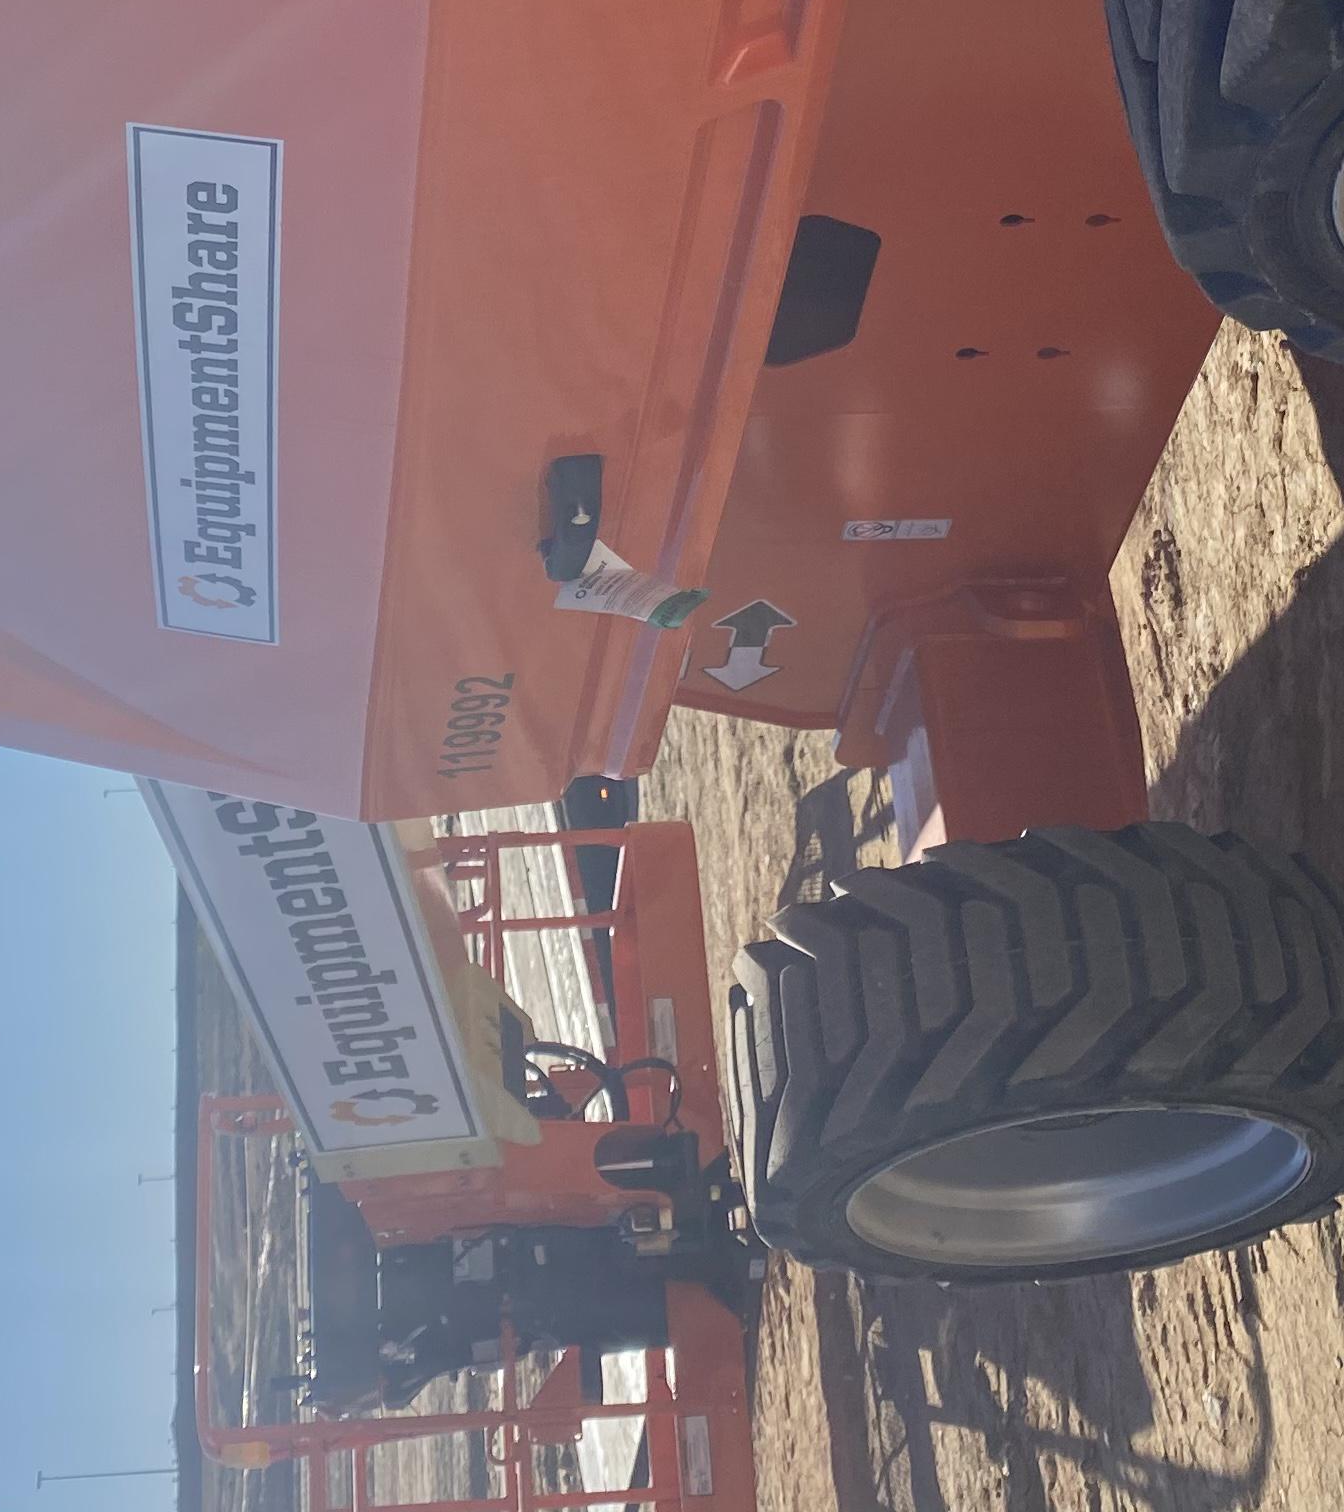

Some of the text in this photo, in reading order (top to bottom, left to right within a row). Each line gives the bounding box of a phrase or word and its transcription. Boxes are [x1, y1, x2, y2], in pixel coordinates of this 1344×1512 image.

[171, 180, 256, 570] EquipmentShare
[437, 673, 515, 780] 119992
[207, 791, 417, 1086] EquipmentS
